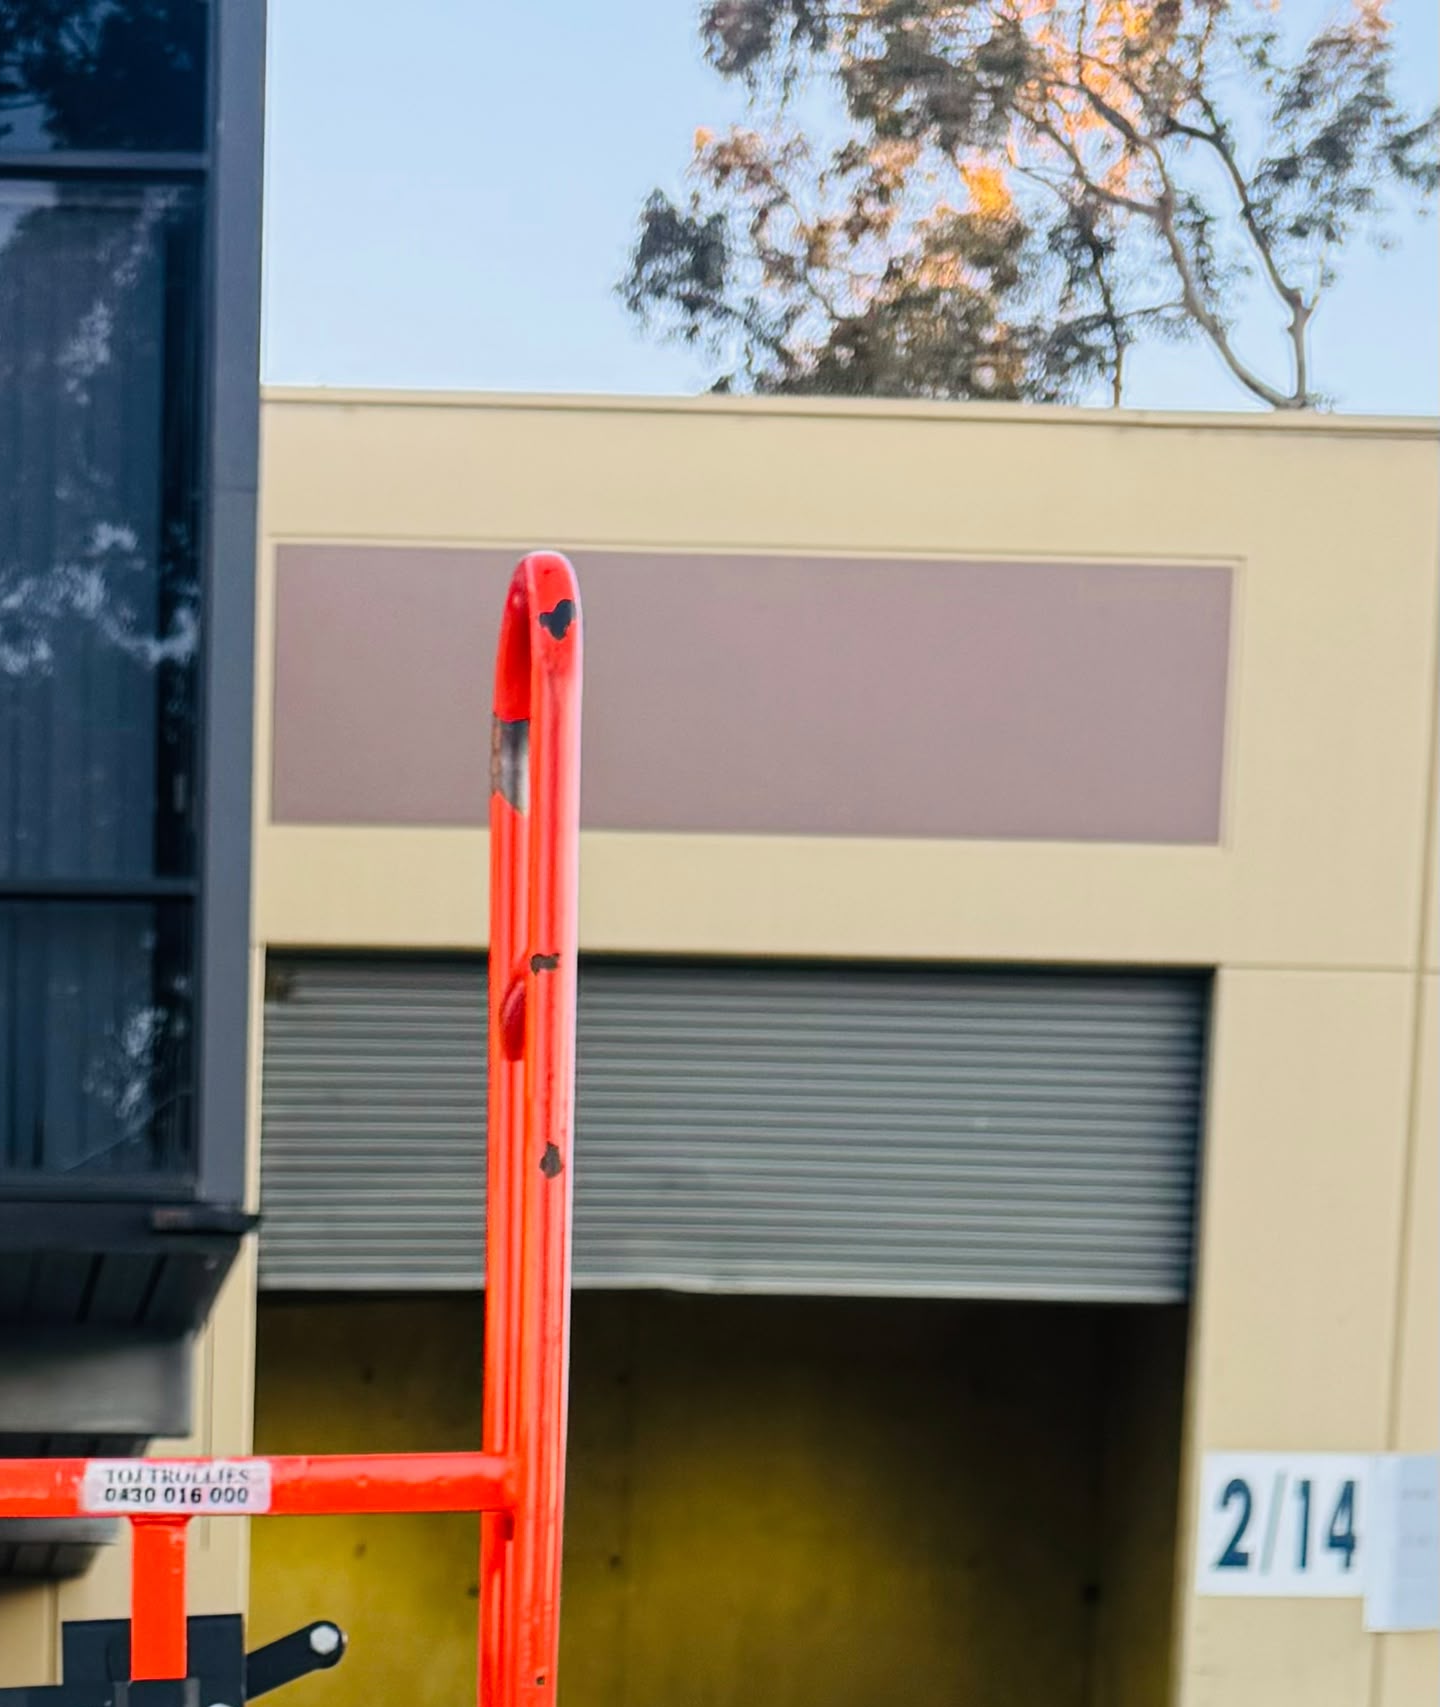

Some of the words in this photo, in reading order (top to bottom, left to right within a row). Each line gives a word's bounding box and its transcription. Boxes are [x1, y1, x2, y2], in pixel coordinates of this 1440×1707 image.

[104, 1486, 156, 1503] 0430
[164, 1486, 202, 1503] 016
[210, 1486, 249, 1503] 000
[1213, 1469, 1357, 1574] 2/14
